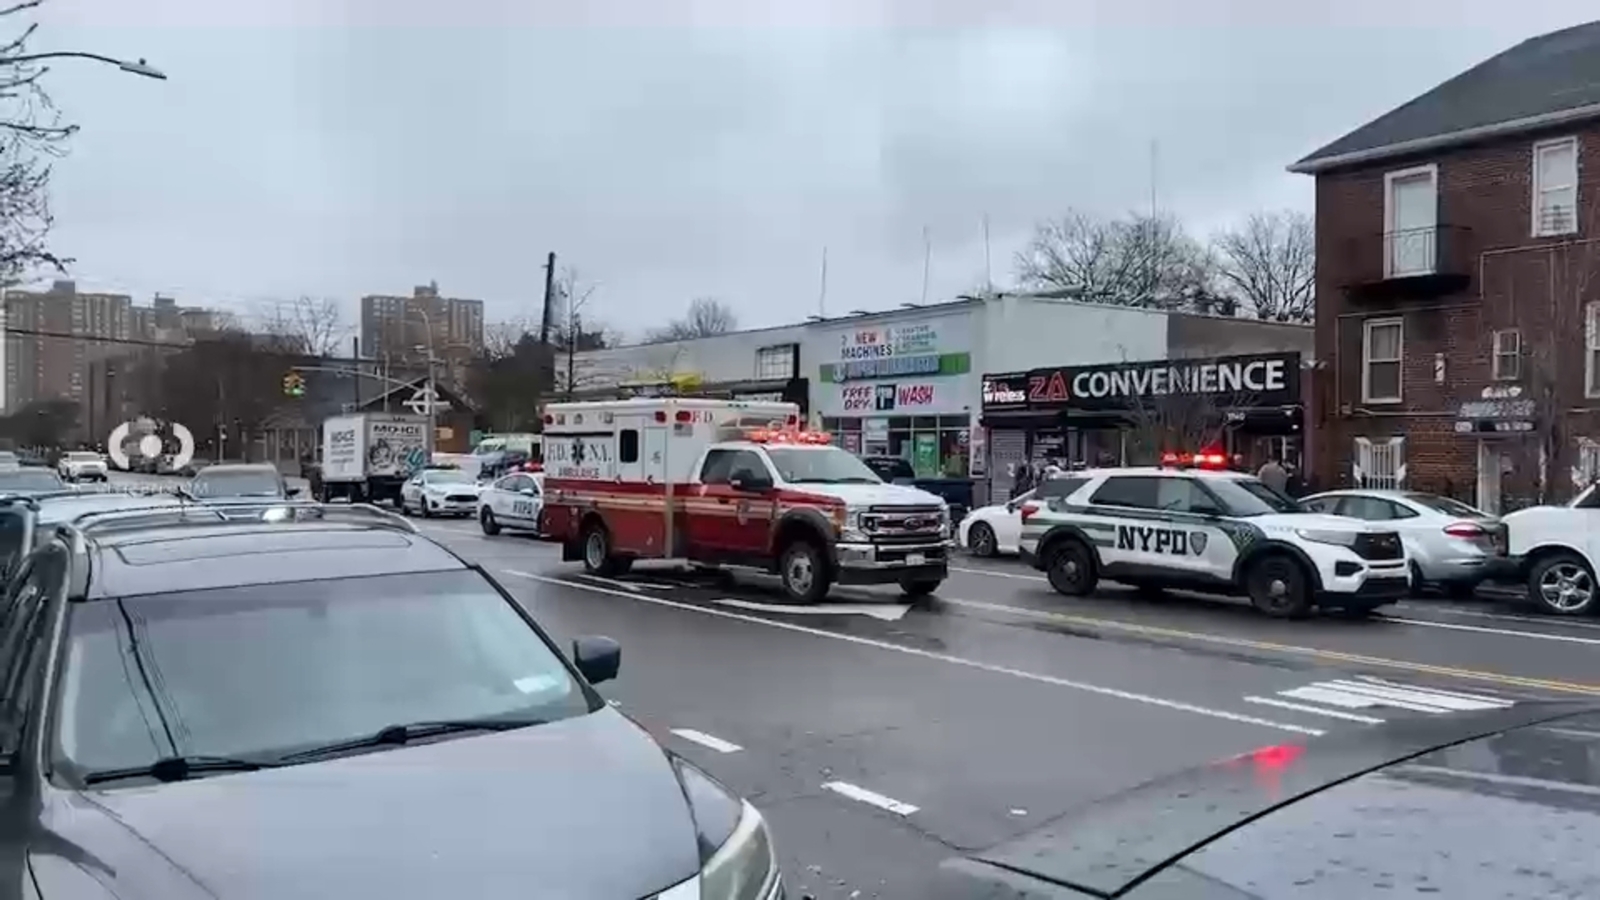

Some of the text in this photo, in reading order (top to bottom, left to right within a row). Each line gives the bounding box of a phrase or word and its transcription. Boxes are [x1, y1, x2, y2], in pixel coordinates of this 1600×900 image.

[855, 331, 878, 345] NEW
[841, 344, 893, 360] MACHINES
[1072, 360, 1286, 398] CONVENIENCE
[842, 386, 872, 399] FREE
[898, 385, 934, 406] WASH
[1117, 524, 1188, 556] NYPD
